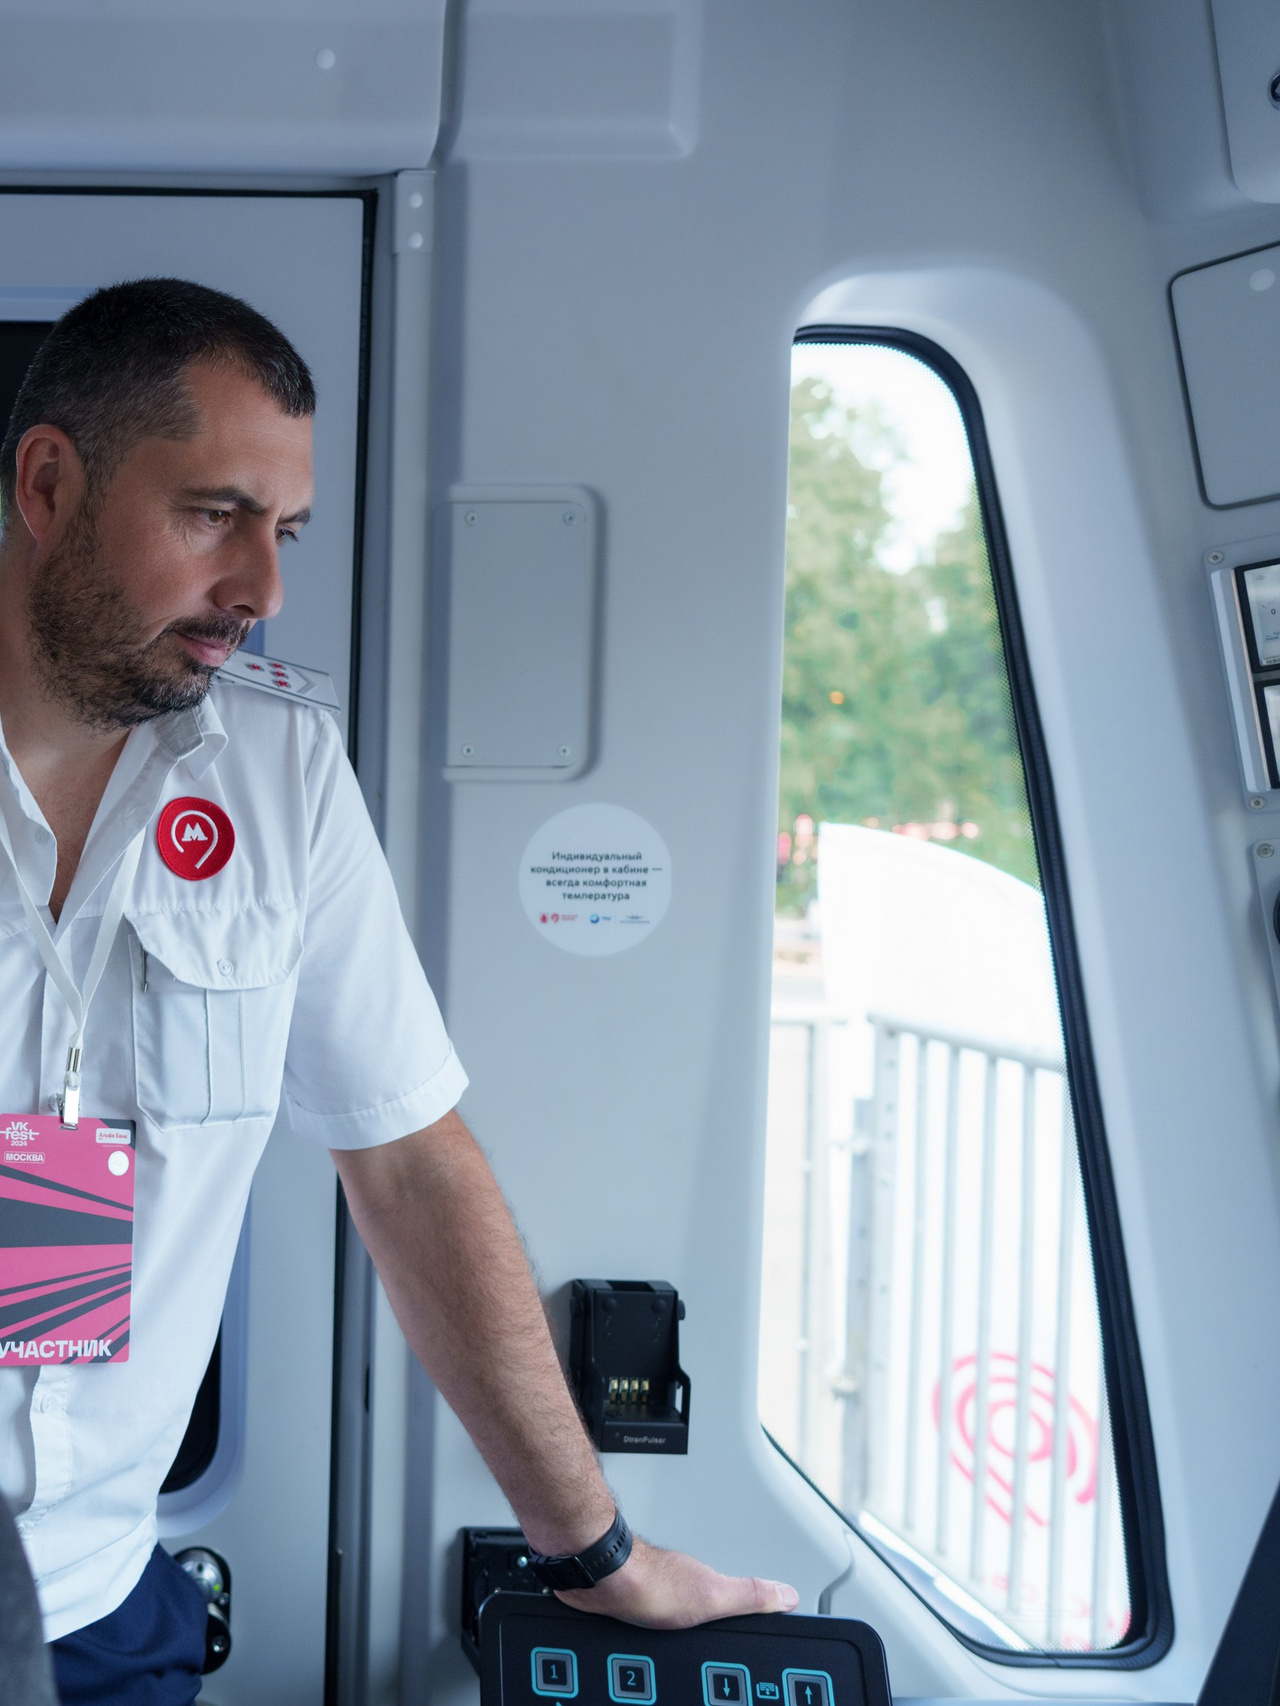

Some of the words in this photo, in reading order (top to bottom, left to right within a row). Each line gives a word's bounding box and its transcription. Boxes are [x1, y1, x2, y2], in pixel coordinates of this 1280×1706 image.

[552, 851, 642, 863] Индивидуальный
[530, 866, 601, 875] кондиционер
[612, 865, 649, 874] кабине
[546, 880, 580, 889] всегда
[582, 878, 647, 889] комфортная
[562, 893, 631, 902] температура
[11, 1121, 29, 1131] VK
[3, 1127, 37, 1141] fest
[6, 1153, 44, 1162] МОСКВА
[550, 1664, 559, 1679] 1
[626, 1671, 637, 1686] 2
